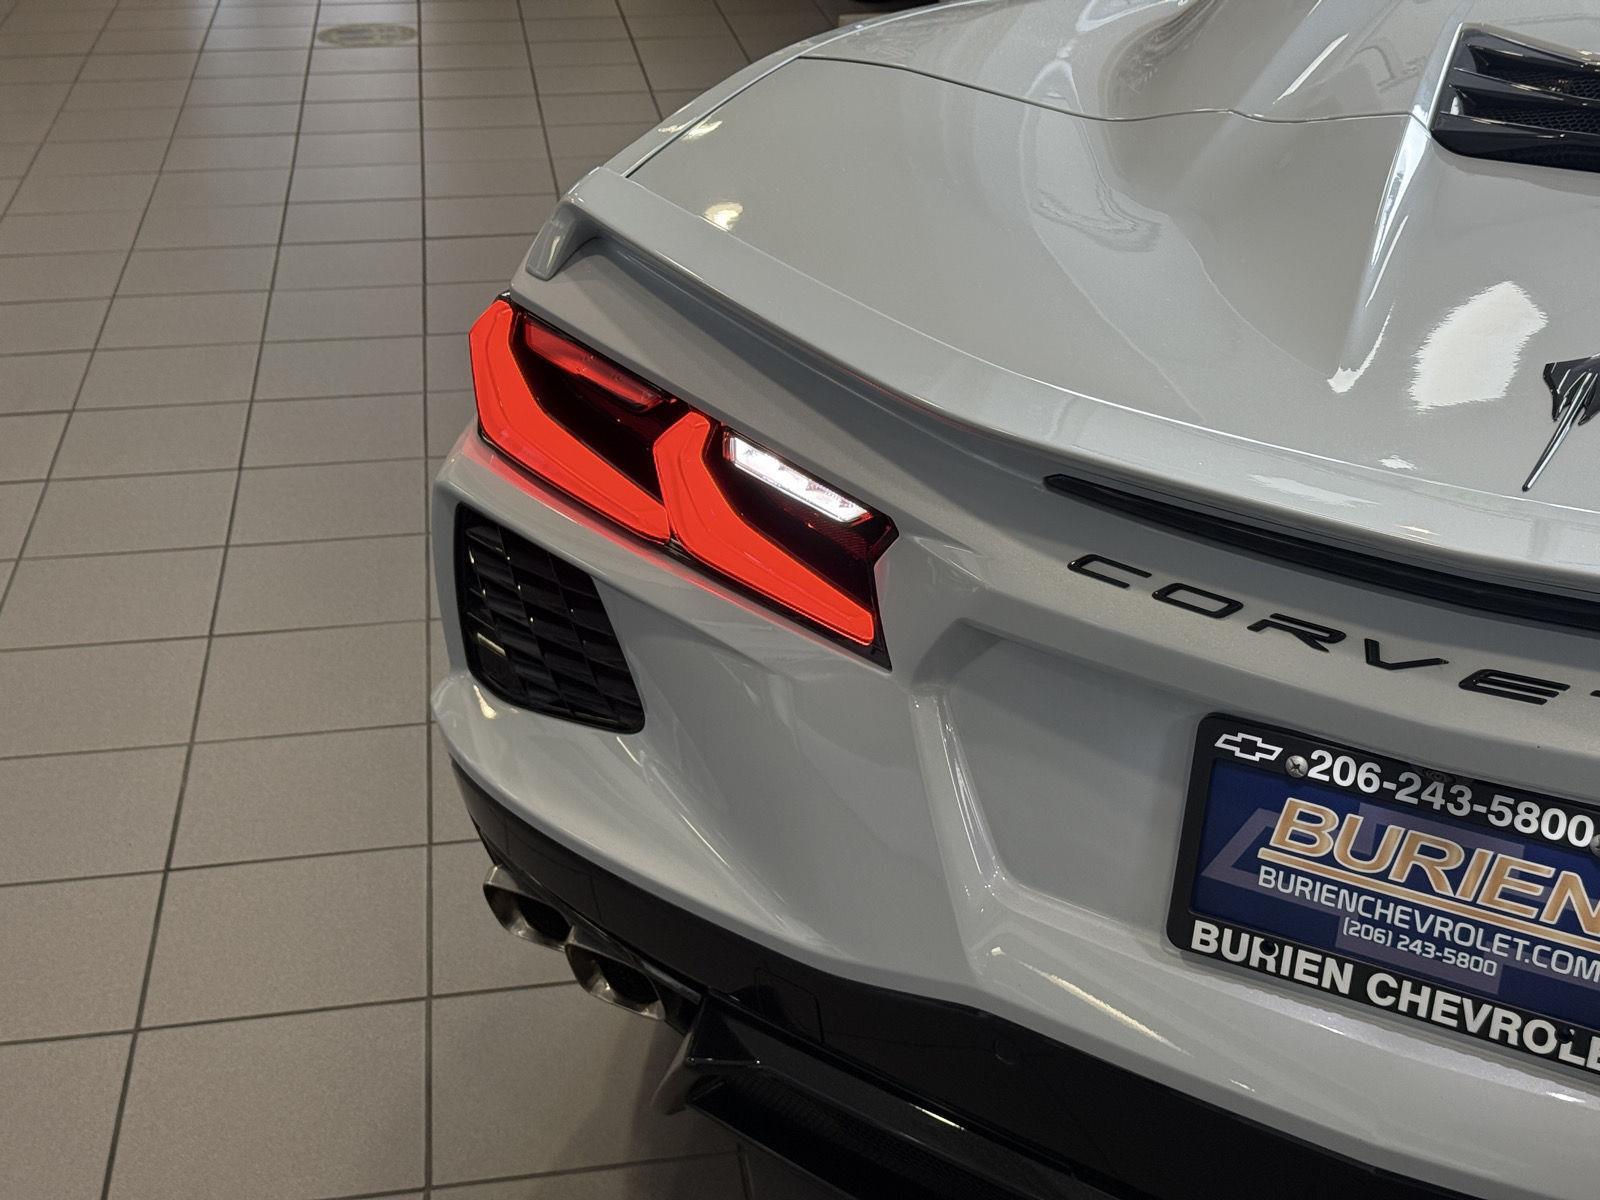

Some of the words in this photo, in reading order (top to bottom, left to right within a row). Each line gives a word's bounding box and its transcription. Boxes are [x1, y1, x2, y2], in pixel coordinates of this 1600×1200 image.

[1067, 553, 1600, 705] CORVE
[1307, 749, 1595, 848] 206-243-5800
[1269, 797, 1600, 936] BURIEN
[1190, 919, 1354, 995] BURIEN
[1257, 864, 1600, 983] BURIENCHEVROLET.COM
[1342, 915, 1394, 948] (206)
[1397, 934, 1498, 977] 243-5800
